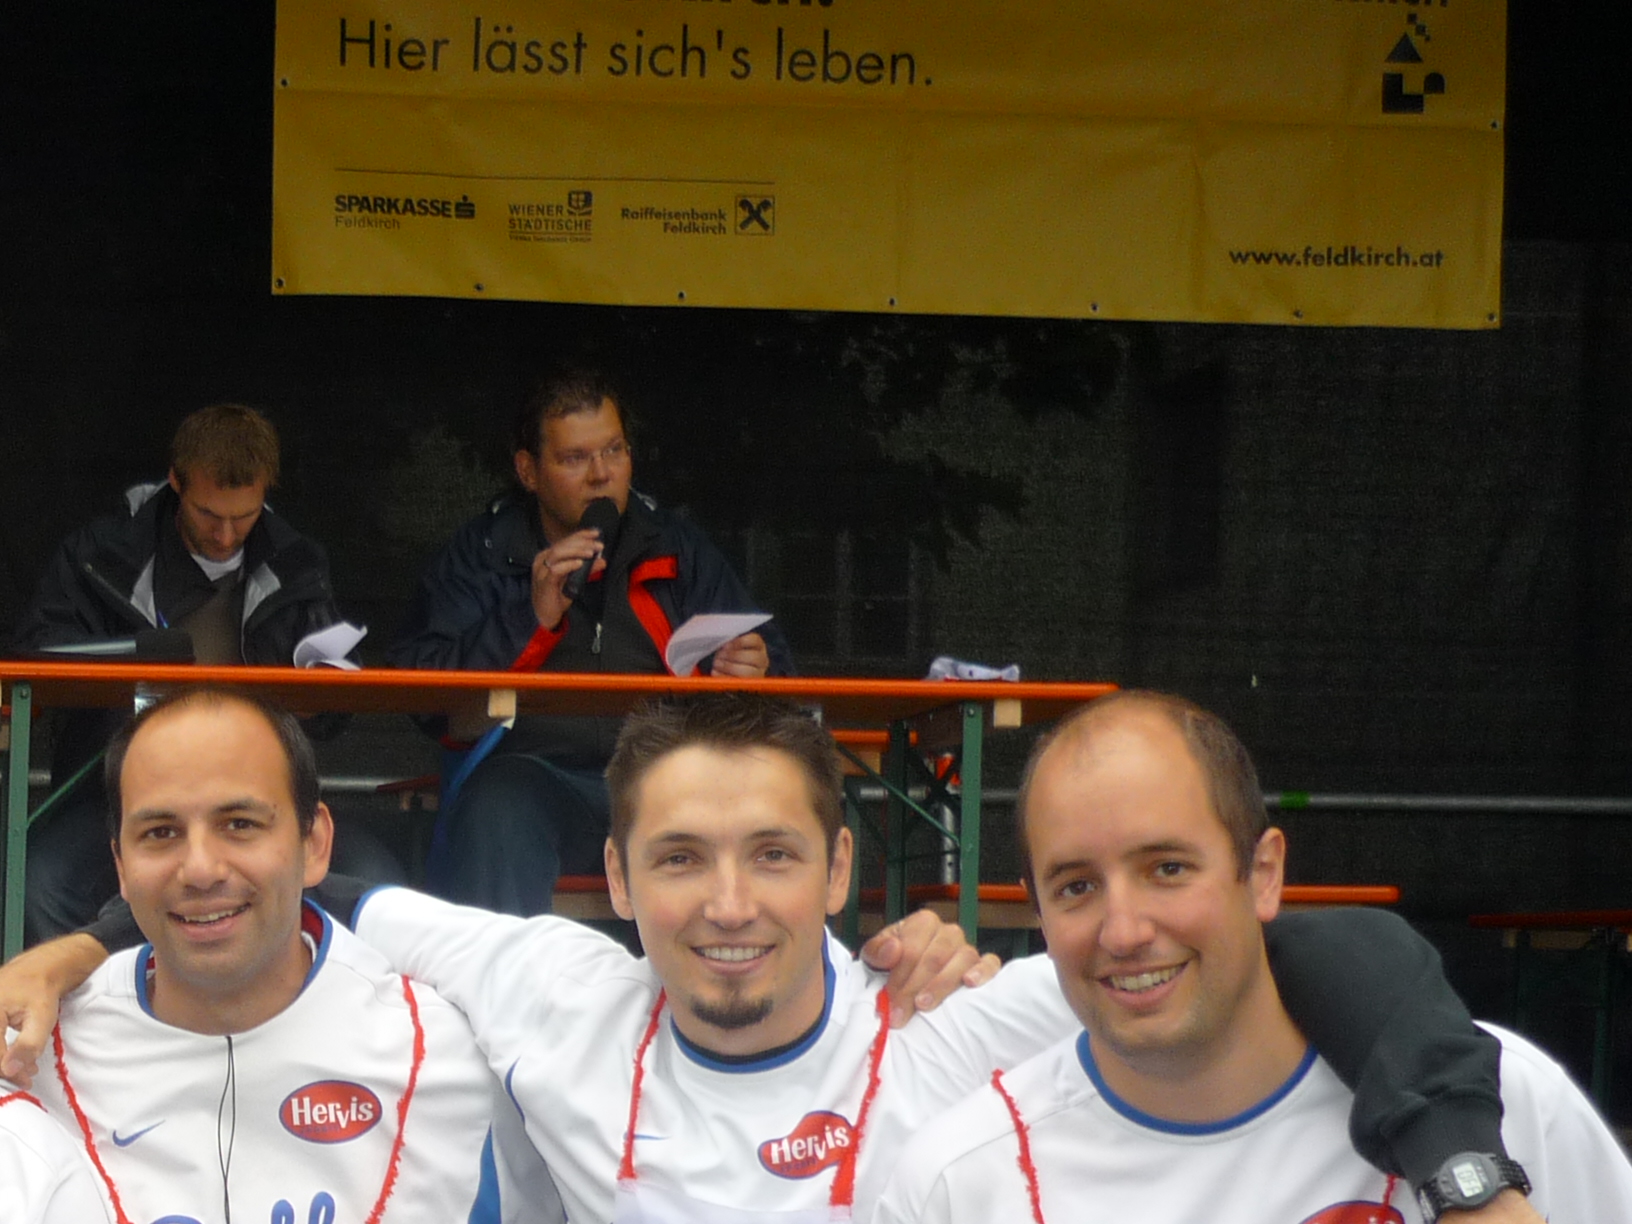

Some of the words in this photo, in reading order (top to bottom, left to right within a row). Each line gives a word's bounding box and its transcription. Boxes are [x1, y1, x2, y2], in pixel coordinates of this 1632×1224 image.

[338, 18, 450, 72] Hier
[472, 17, 587, 75] lässt
[607, 23, 752, 80] sich's
[775, 27, 933, 87] leben.
[334, 195, 454, 219] SPARKASSE
[508, 204, 564, 216] WIENER
[621, 206, 727, 222] Raiffeisenbank
[334, 215, 400, 231] Feldkirch
[508, 217, 593, 232] STÄDTISCHE
[662, 221, 727, 235] Feldkirch
[1229, 246, 1444, 269] www.feldkirch.at
[290, 1095, 375, 1129] Hervis
[770, 1125, 850, 1165] Hervis
